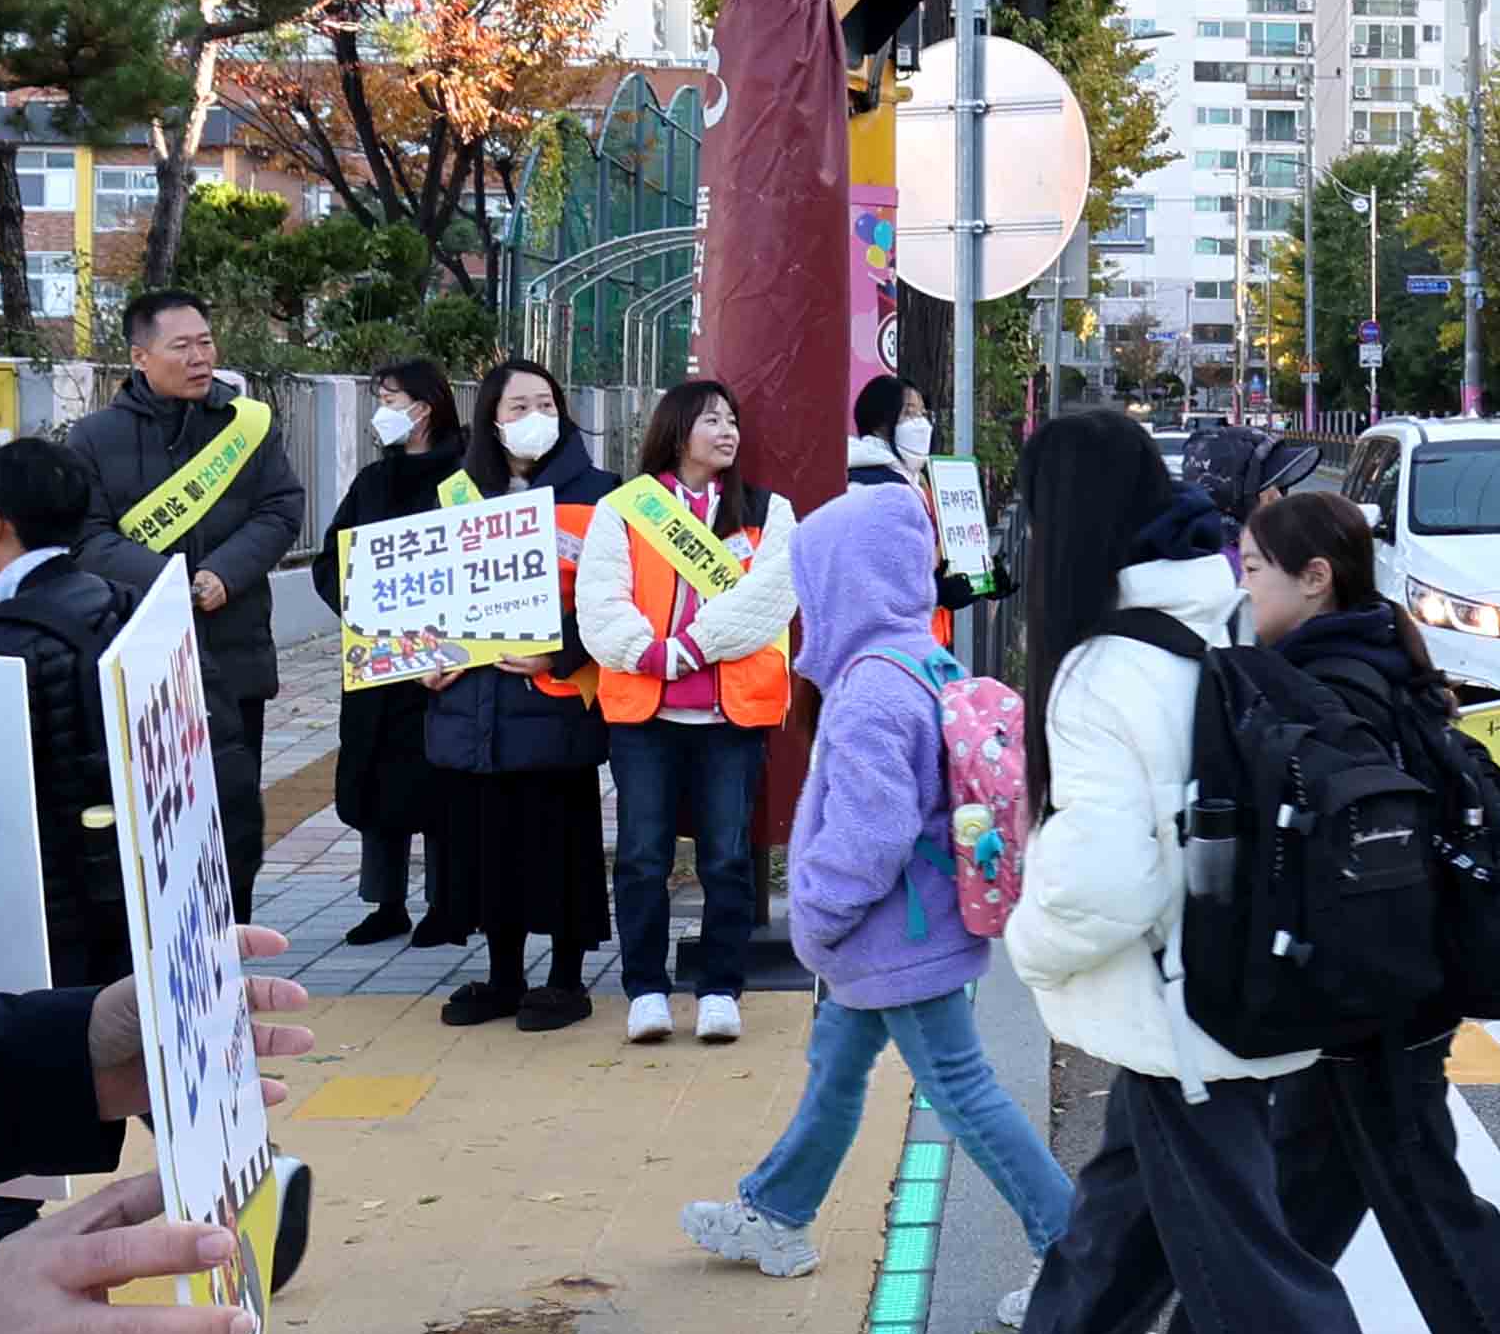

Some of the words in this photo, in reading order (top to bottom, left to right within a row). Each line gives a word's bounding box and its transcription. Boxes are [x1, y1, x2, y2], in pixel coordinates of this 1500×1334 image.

[370, 525, 449, 571] 멈추고
[456, 506, 541, 553] 살피고
[372, 567, 455, 614] 천천히
[463, 548, 547, 595] 건너요
[137, 679, 182, 895] 멈추고
[167, 876, 213, 1129] 천천히
[197, 803, 231, 999] 건너요
